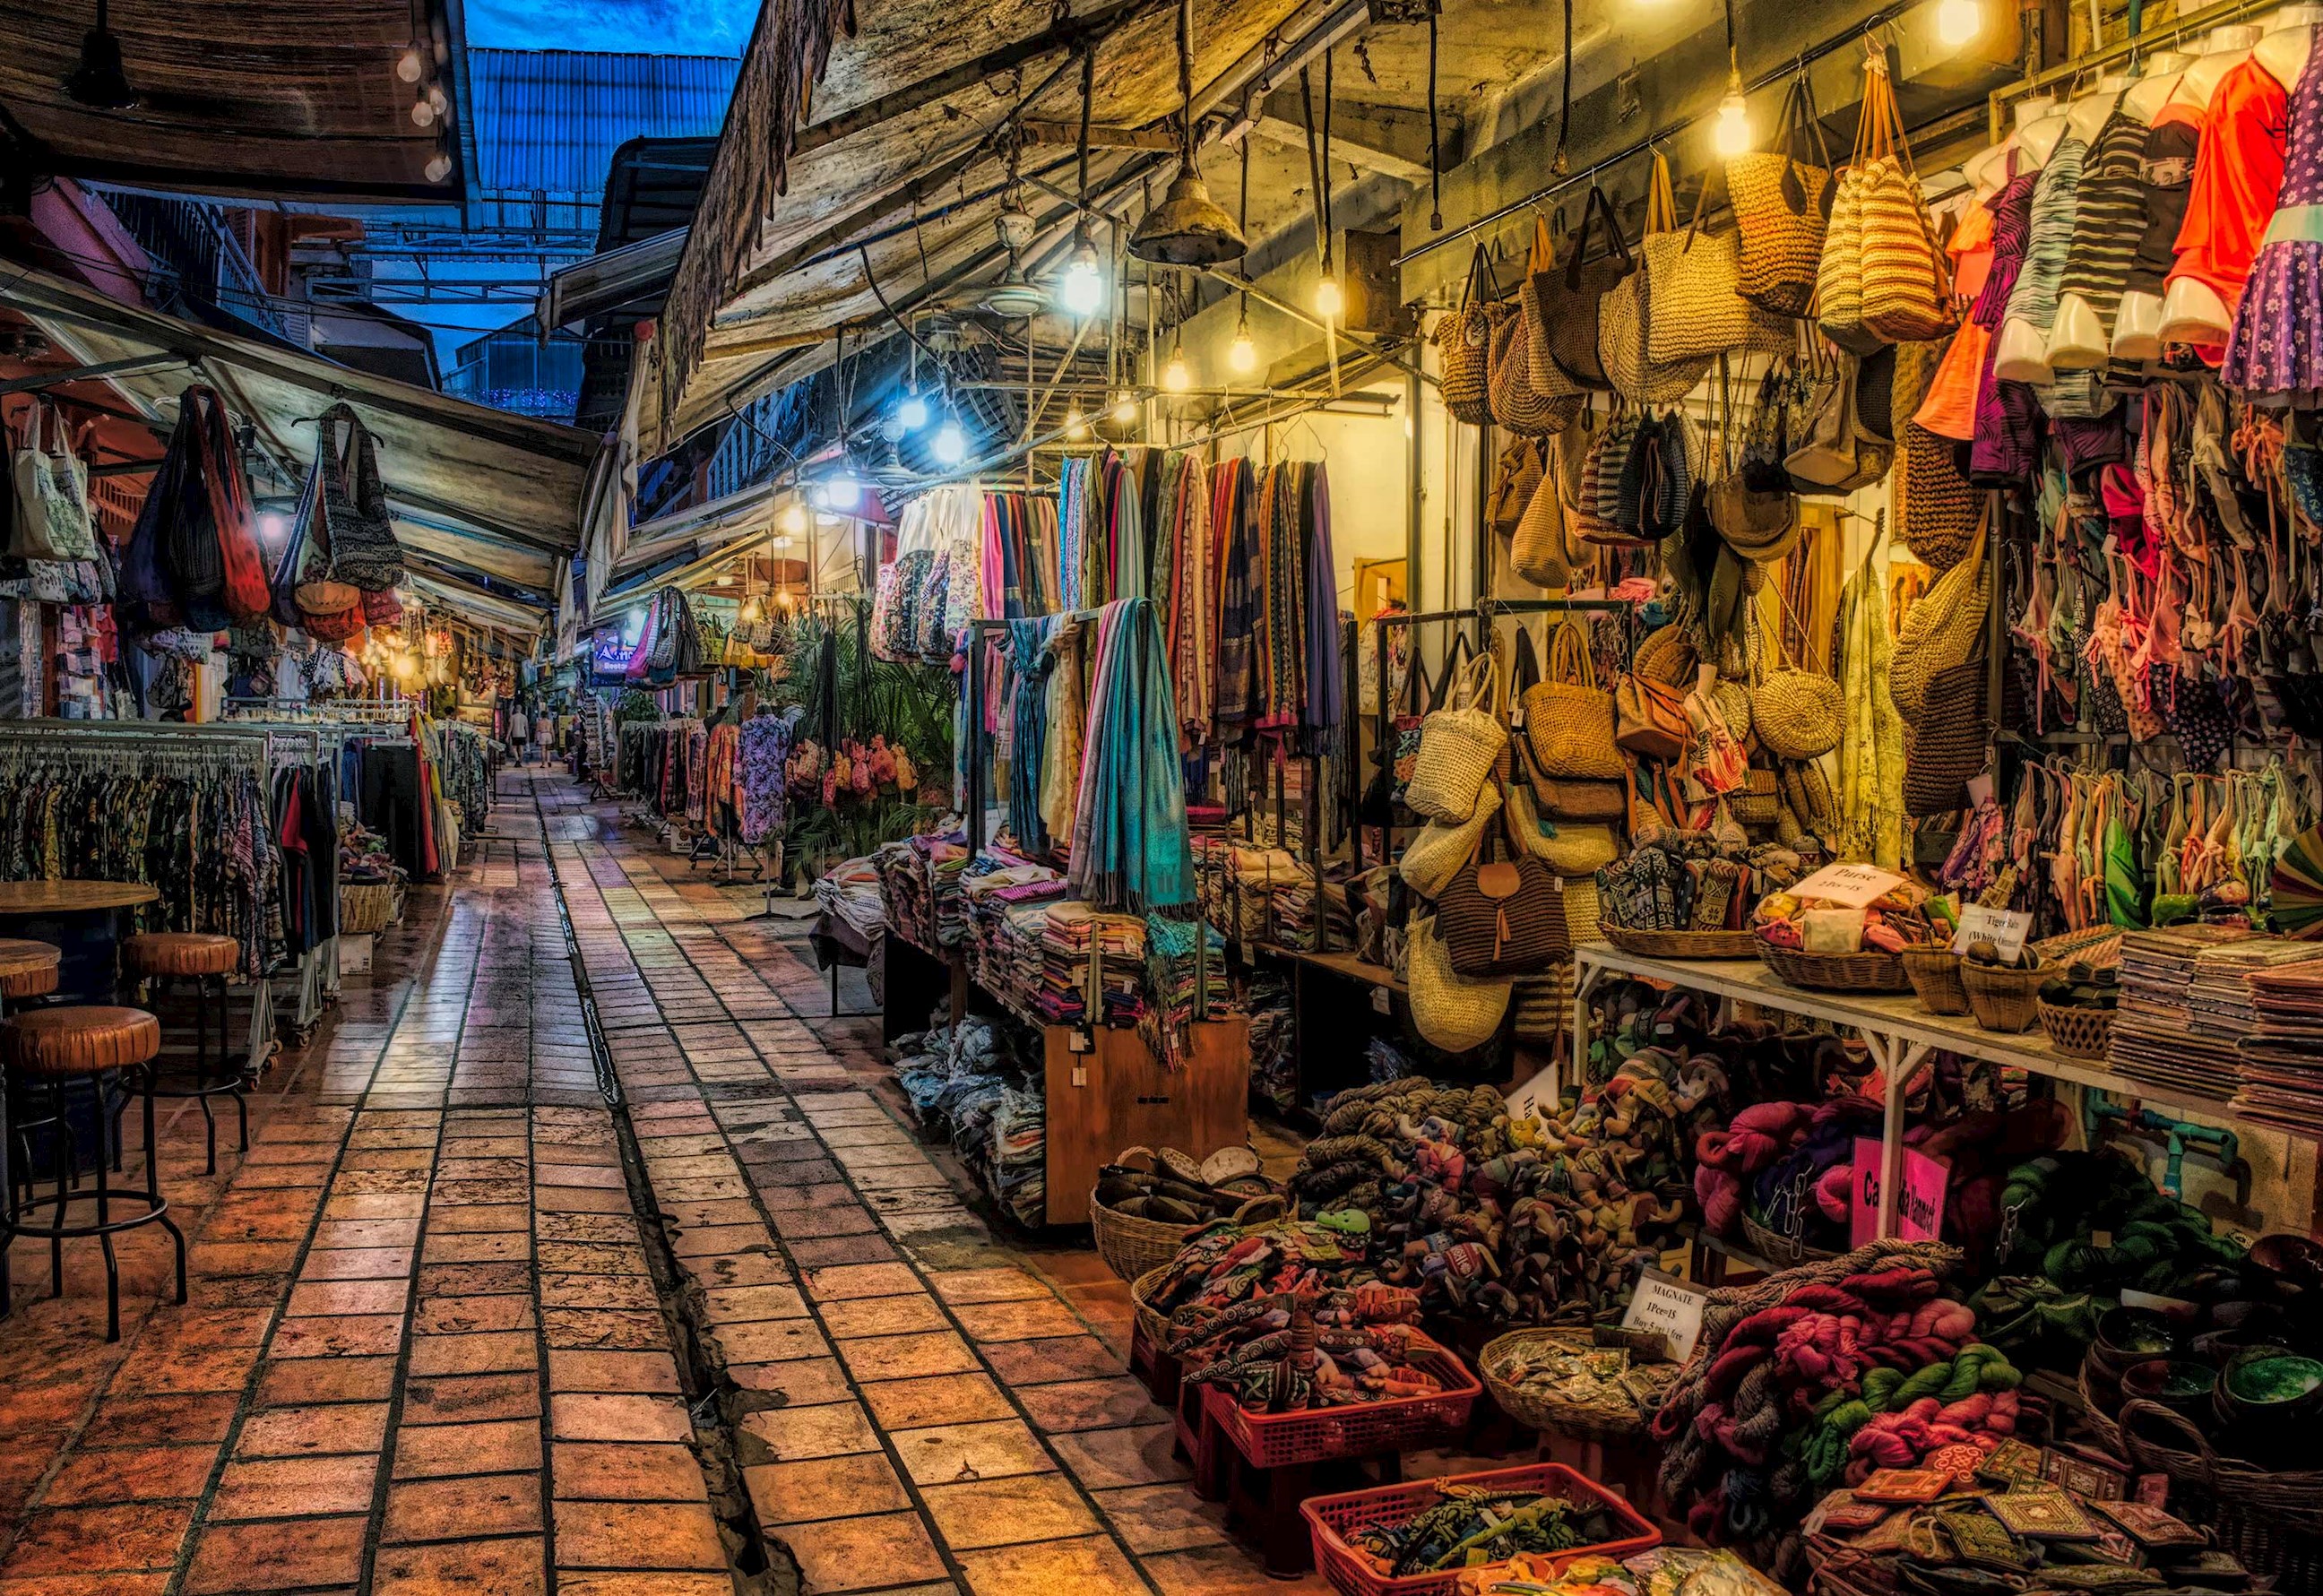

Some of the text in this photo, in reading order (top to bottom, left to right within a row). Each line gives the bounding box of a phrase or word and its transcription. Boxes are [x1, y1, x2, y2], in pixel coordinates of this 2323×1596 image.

[1834, 868, 1877, 881] Purse
[1987, 915, 2007, 928] Tiger
[1968, 931, 1997, 945] (White
[1653, 1284, 1693, 1306] MAGNATE
[1646, 1301, 1677, 1319] 1Pce=1$
[1633, 1316, 1648, 1330] Buy
[1648, 1322, 1655, 1331] 5
[1671, 1329, 1683, 1342] free
